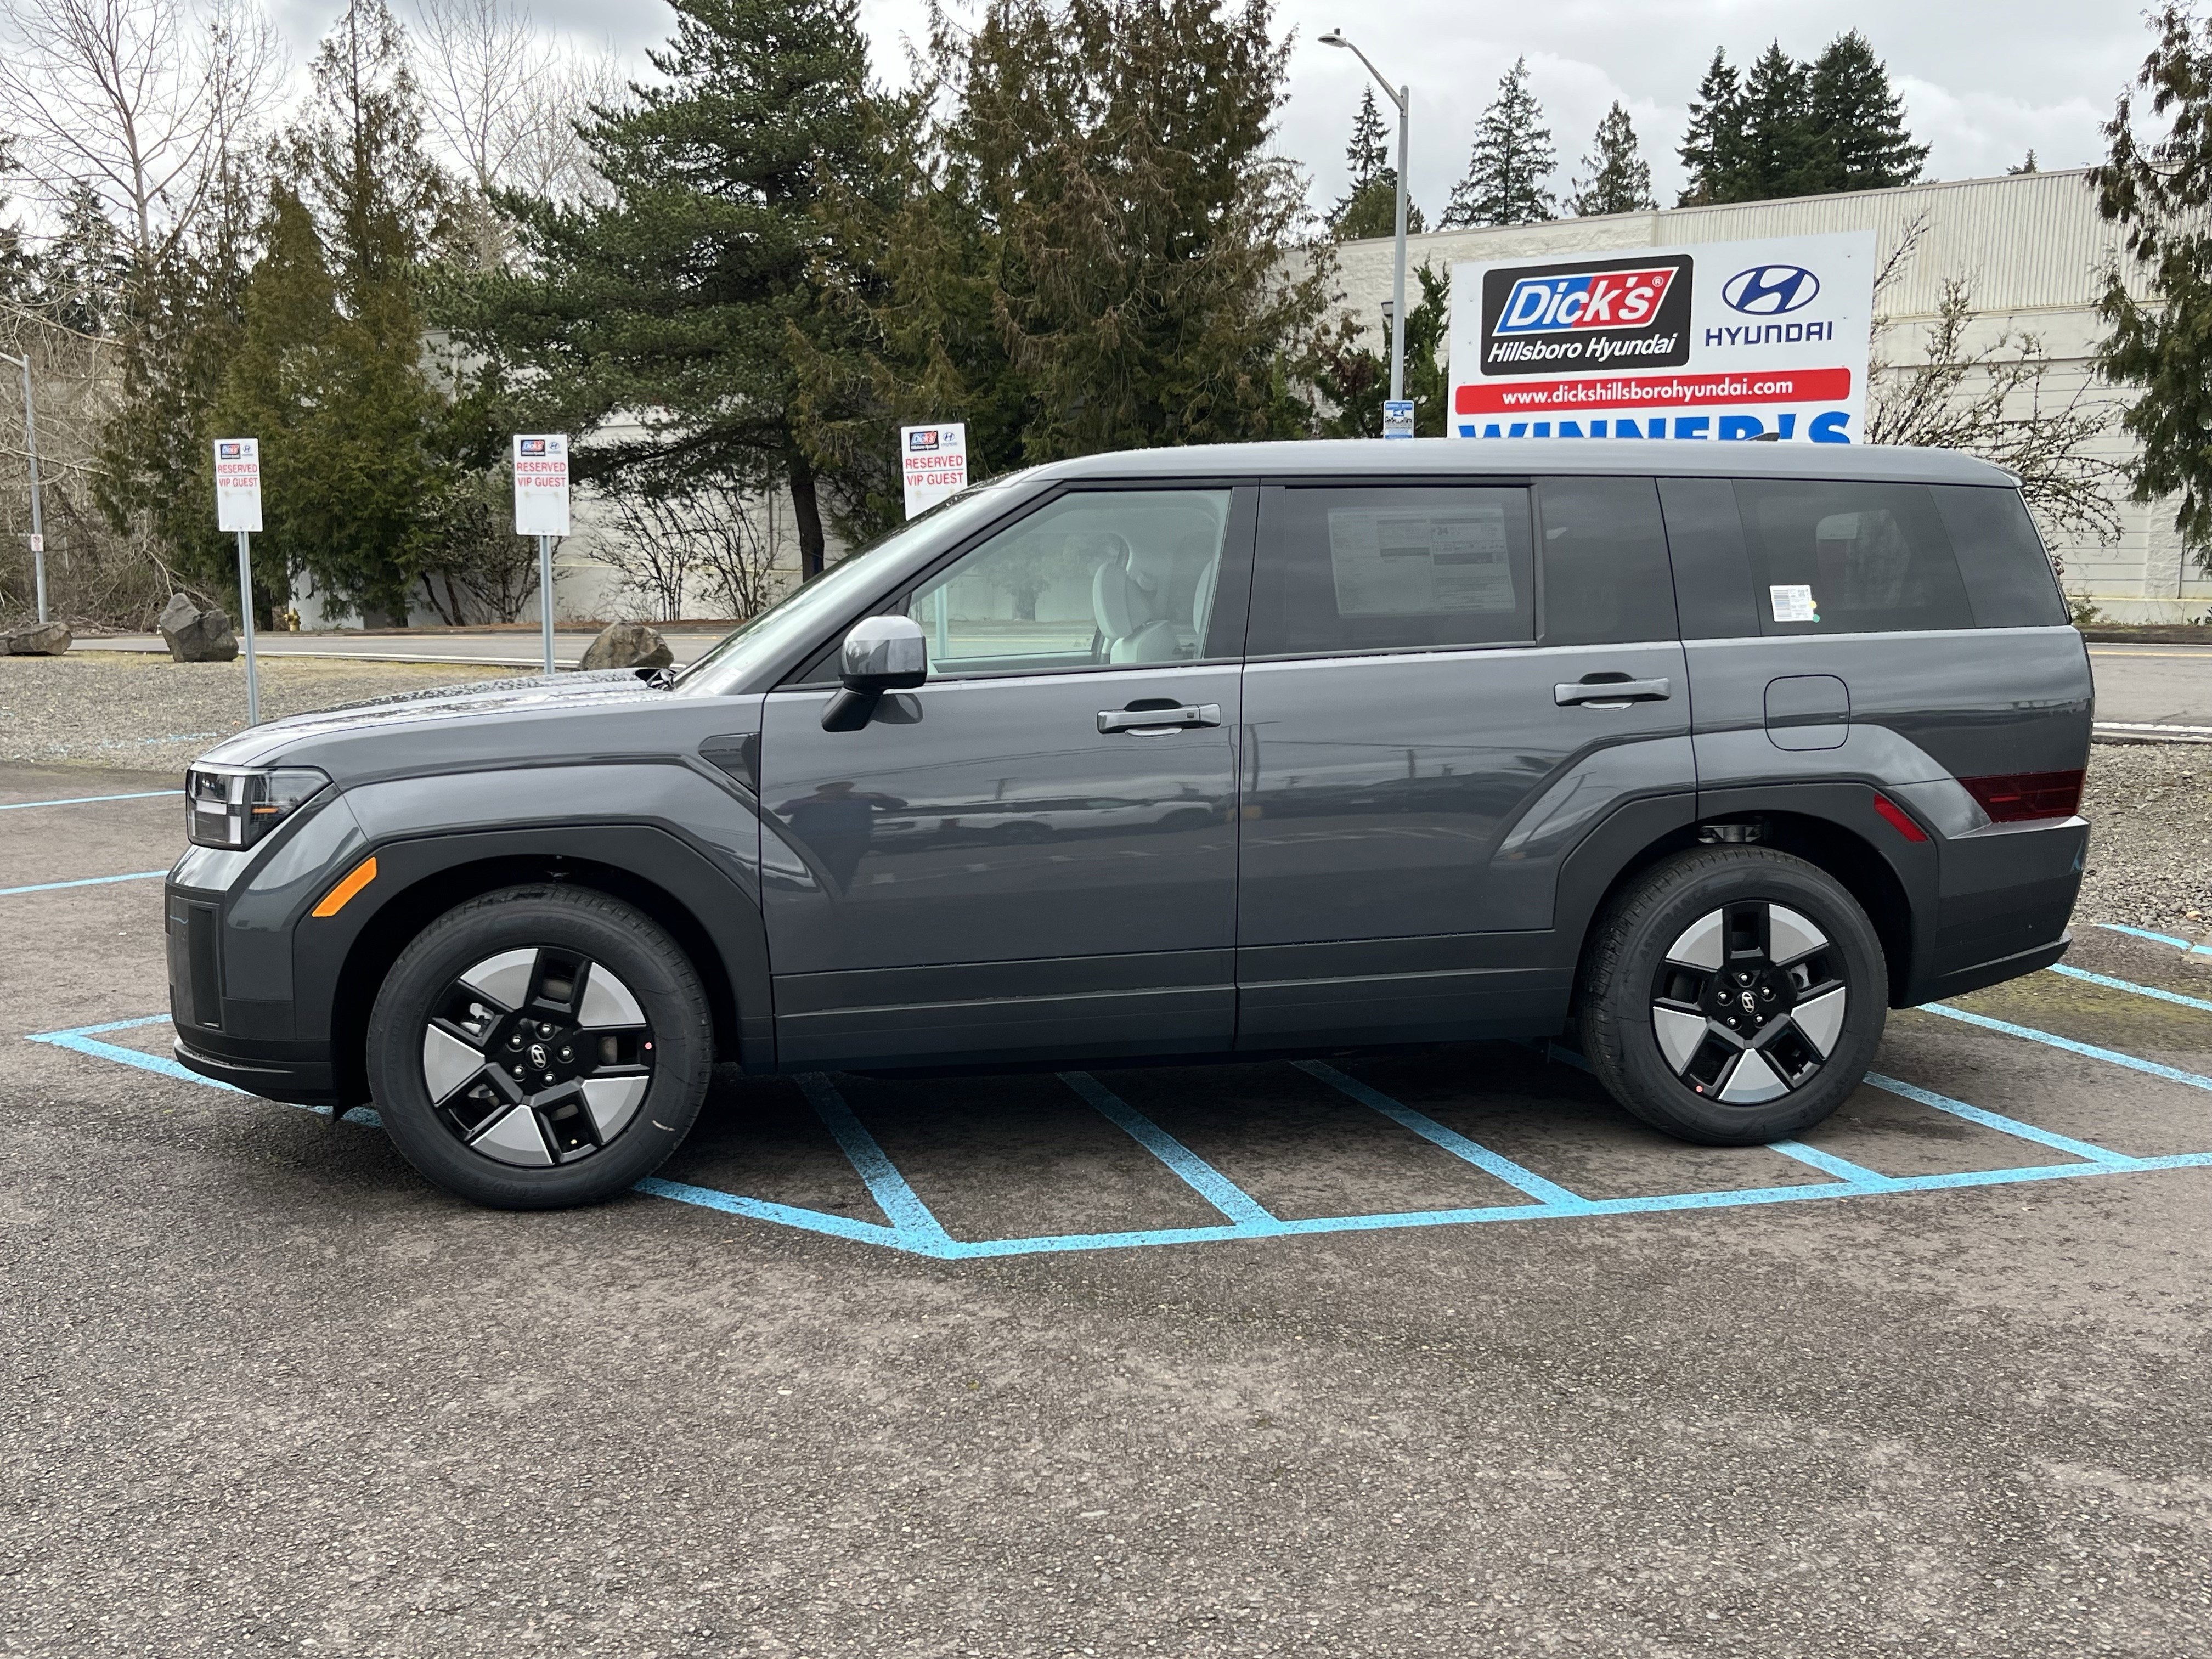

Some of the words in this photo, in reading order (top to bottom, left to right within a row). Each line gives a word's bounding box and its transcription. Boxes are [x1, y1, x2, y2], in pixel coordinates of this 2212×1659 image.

[1705, 321, 1832, 347] HYUNDAI
[1488, 341, 1582, 363] Hillsboro
[1585, 333, 1678, 362] Hyundai
[1502, 377, 1793, 404] www.dickshillsborohyundai.com
[218, 464, 257, 473] RESERVED
[517, 462, 566, 472] RESERVED
[906, 455, 963, 469] RESERVED
[219, 478, 230, 487] VIP
[233, 477, 258, 487] GUEST
[517, 477, 532, 487] VIP
[535, 477, 566, 487] GUEST
[907, 475, 923, 486] VIP
[927, 472, 963, 485] GUEST
